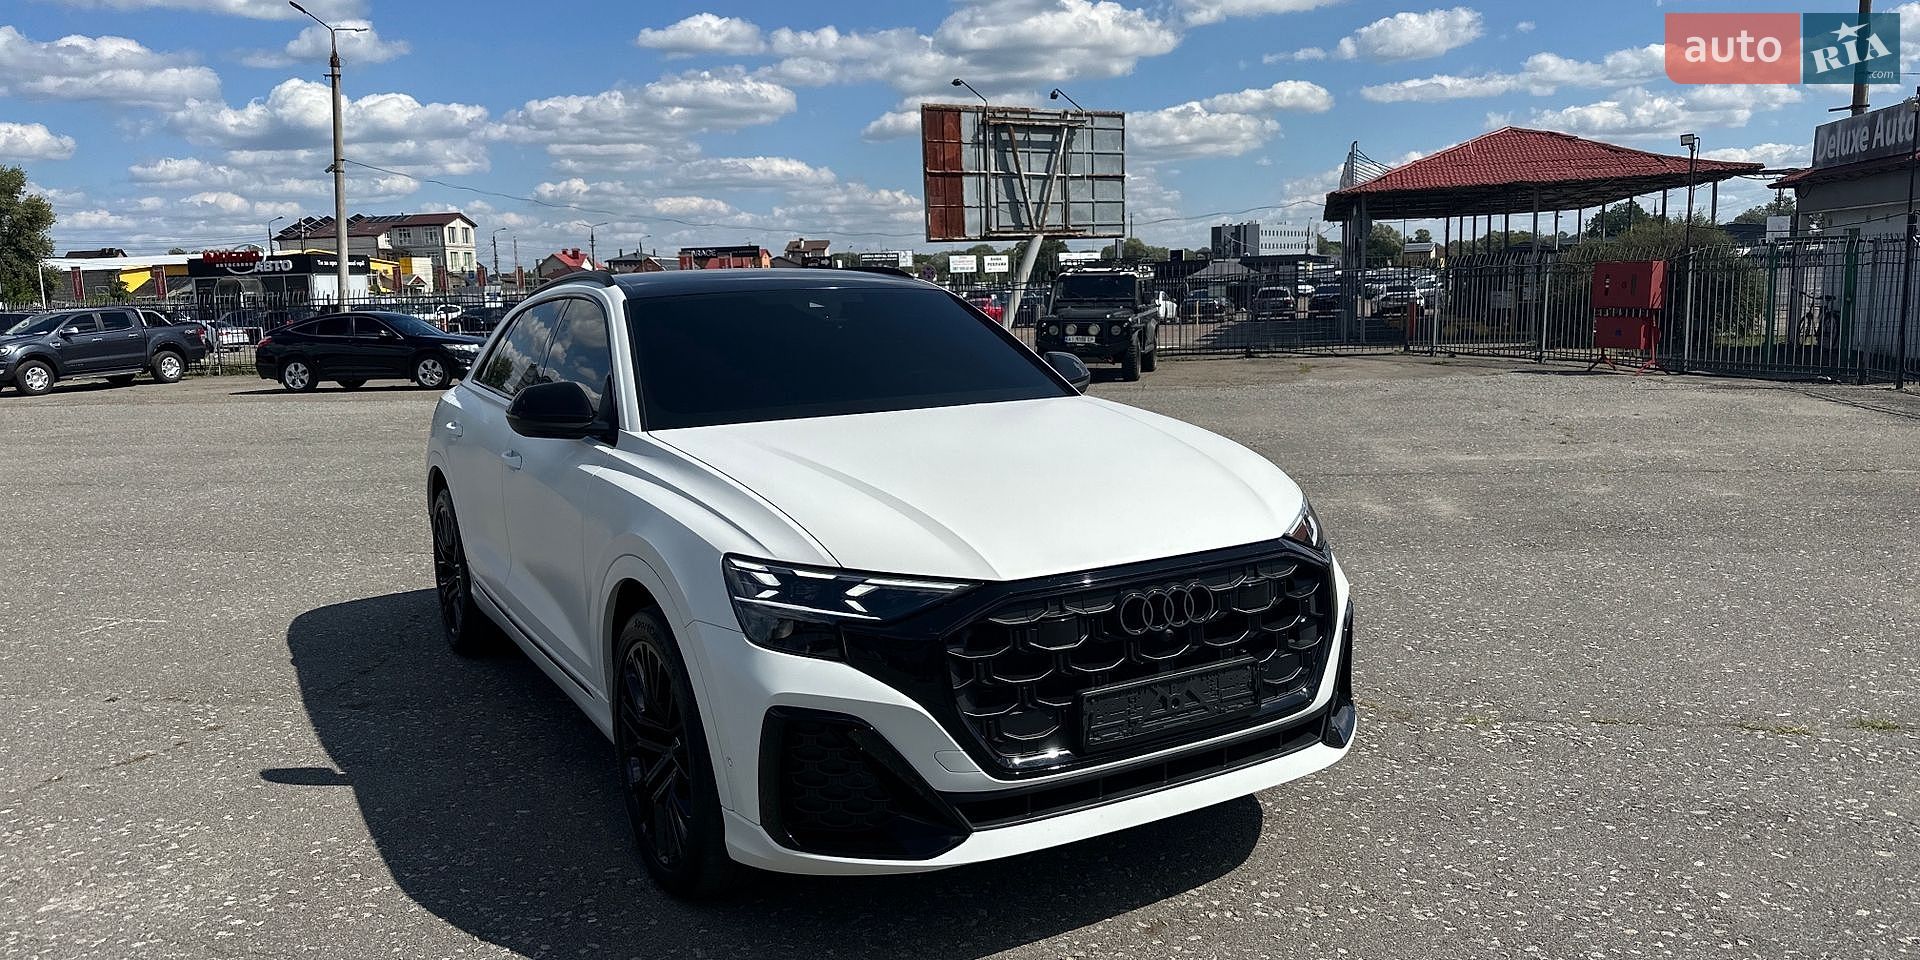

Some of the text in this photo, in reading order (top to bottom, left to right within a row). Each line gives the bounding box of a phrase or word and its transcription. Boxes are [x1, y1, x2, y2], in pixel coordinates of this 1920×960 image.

[1816, 112, 1916, 161] Deluxe Auto
[253, 259, 293, 273] АВТО
